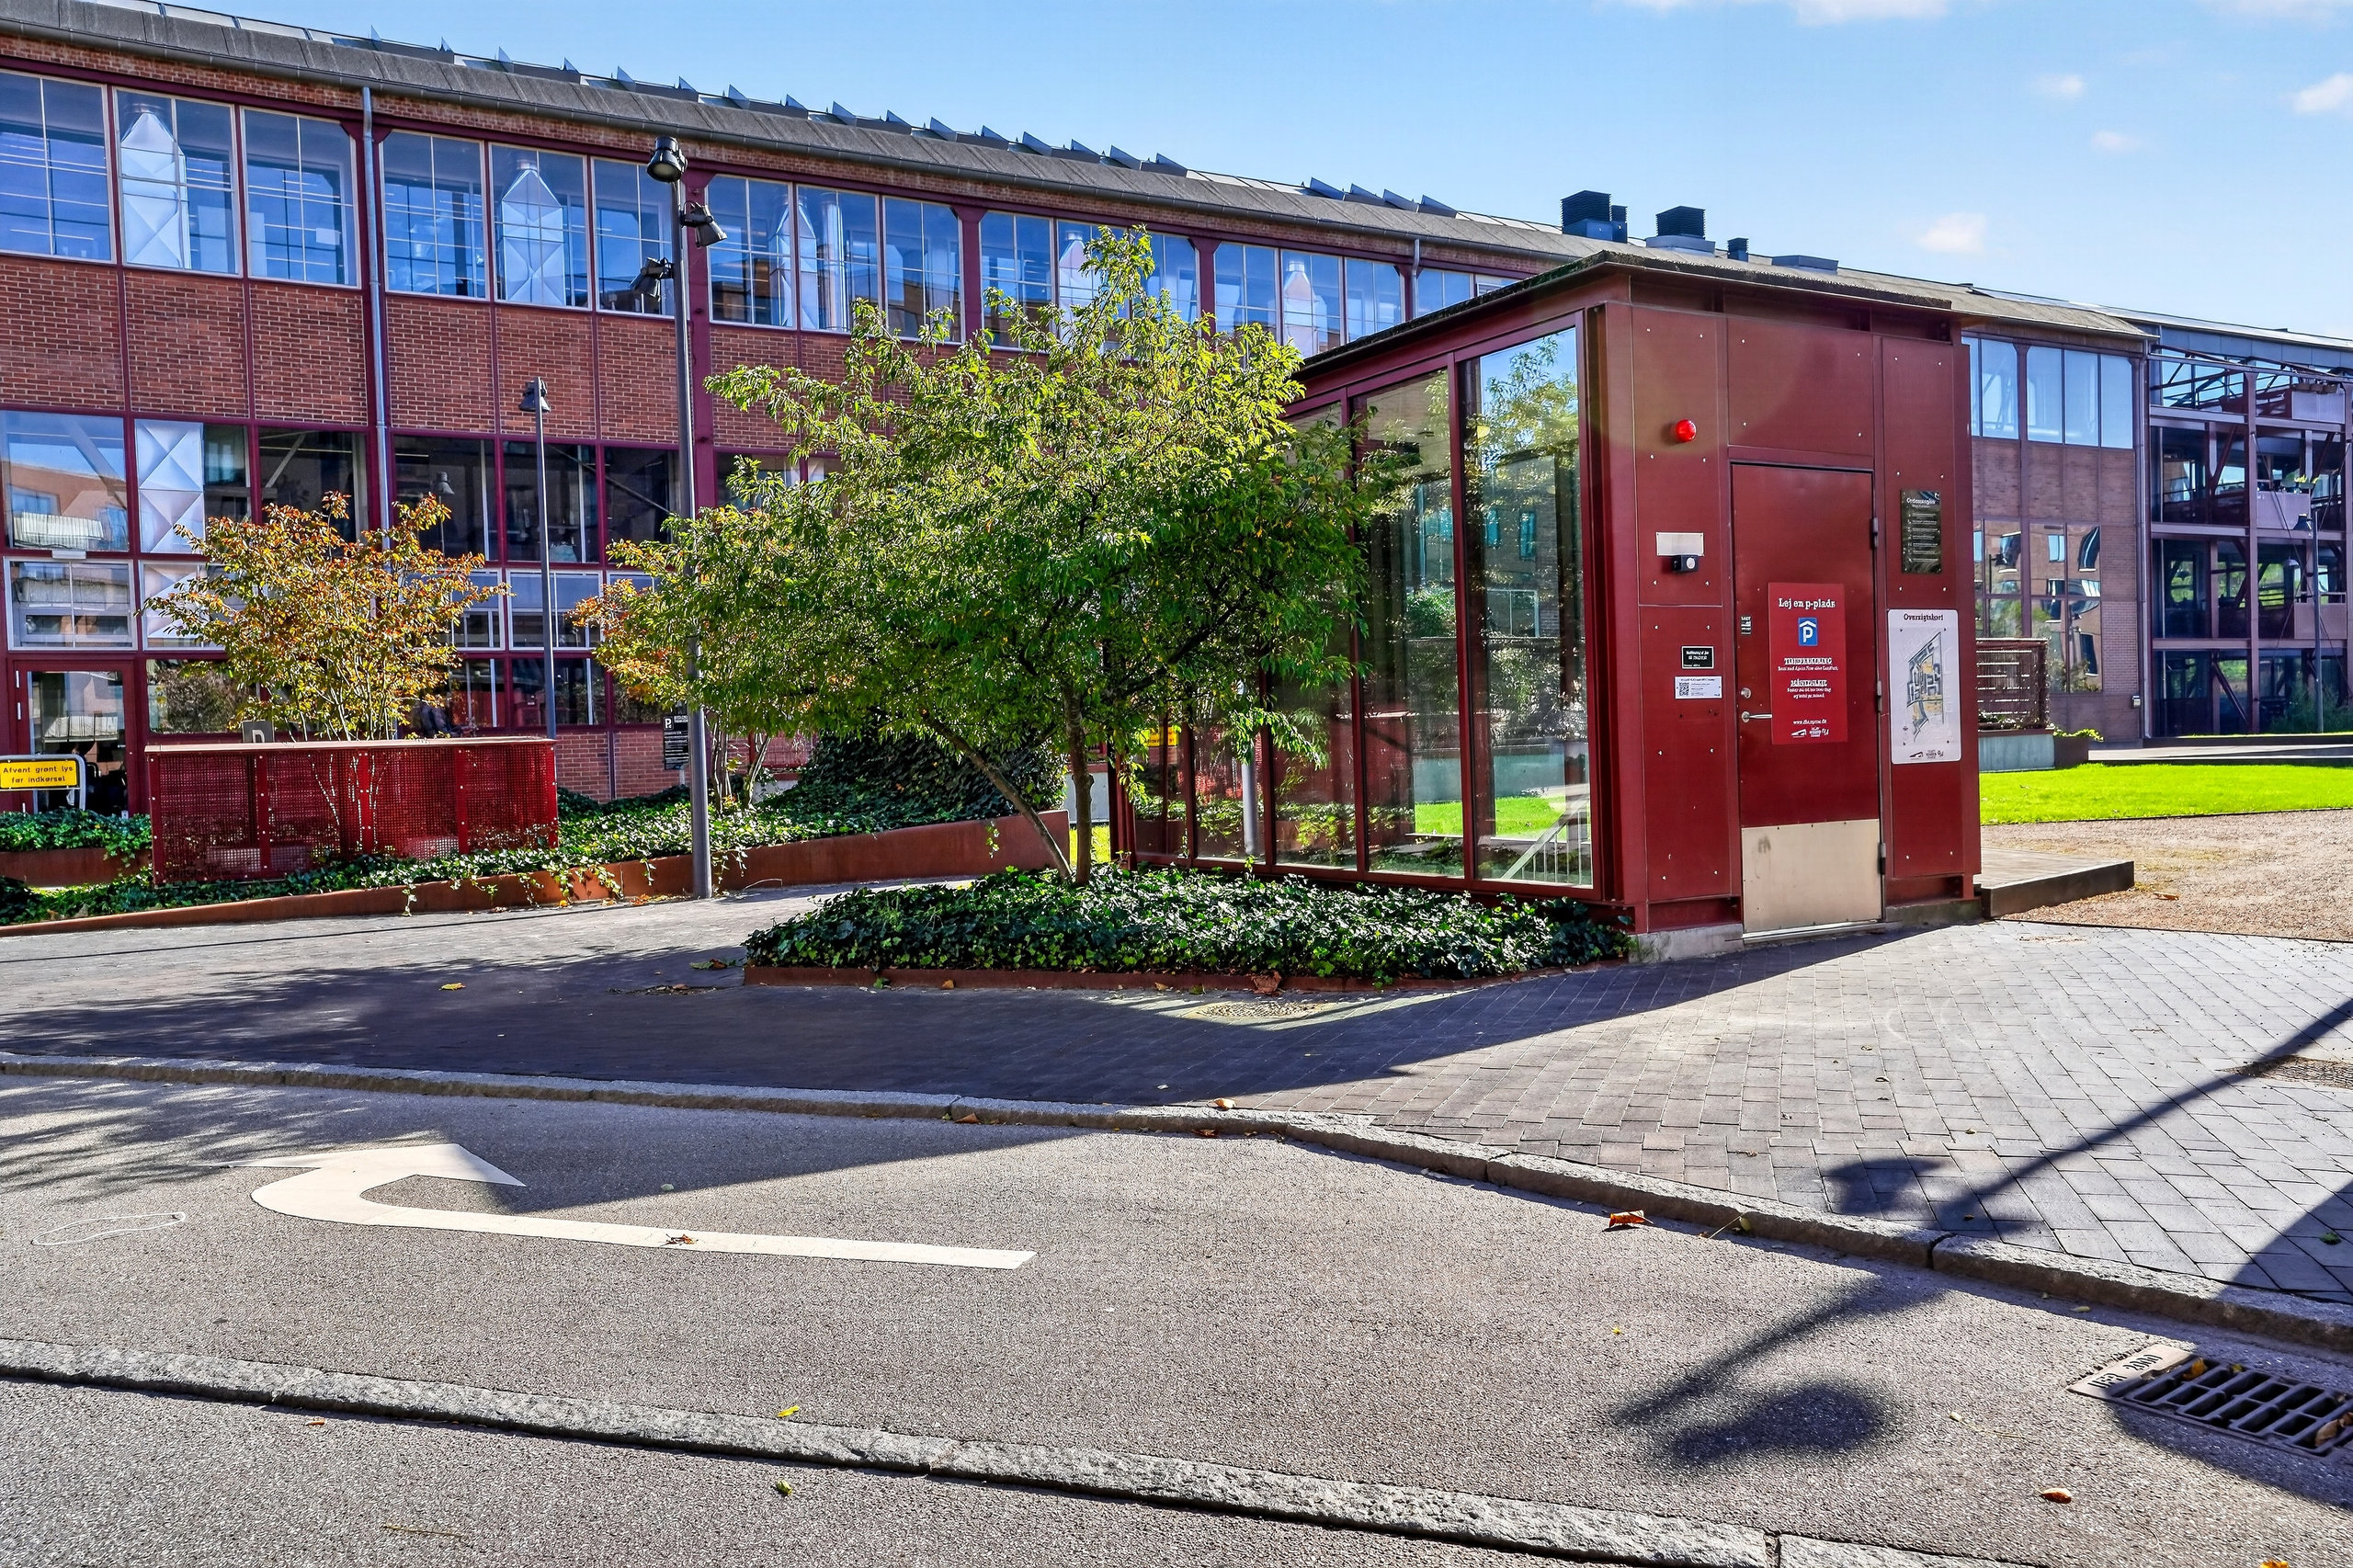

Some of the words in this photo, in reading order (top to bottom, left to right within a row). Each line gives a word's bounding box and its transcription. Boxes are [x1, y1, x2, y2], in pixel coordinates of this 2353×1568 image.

[1802, 626, 1813, 643] P
[35, 766, 57, 774] grønt
[28, 775, 65, 783] indkørsel
